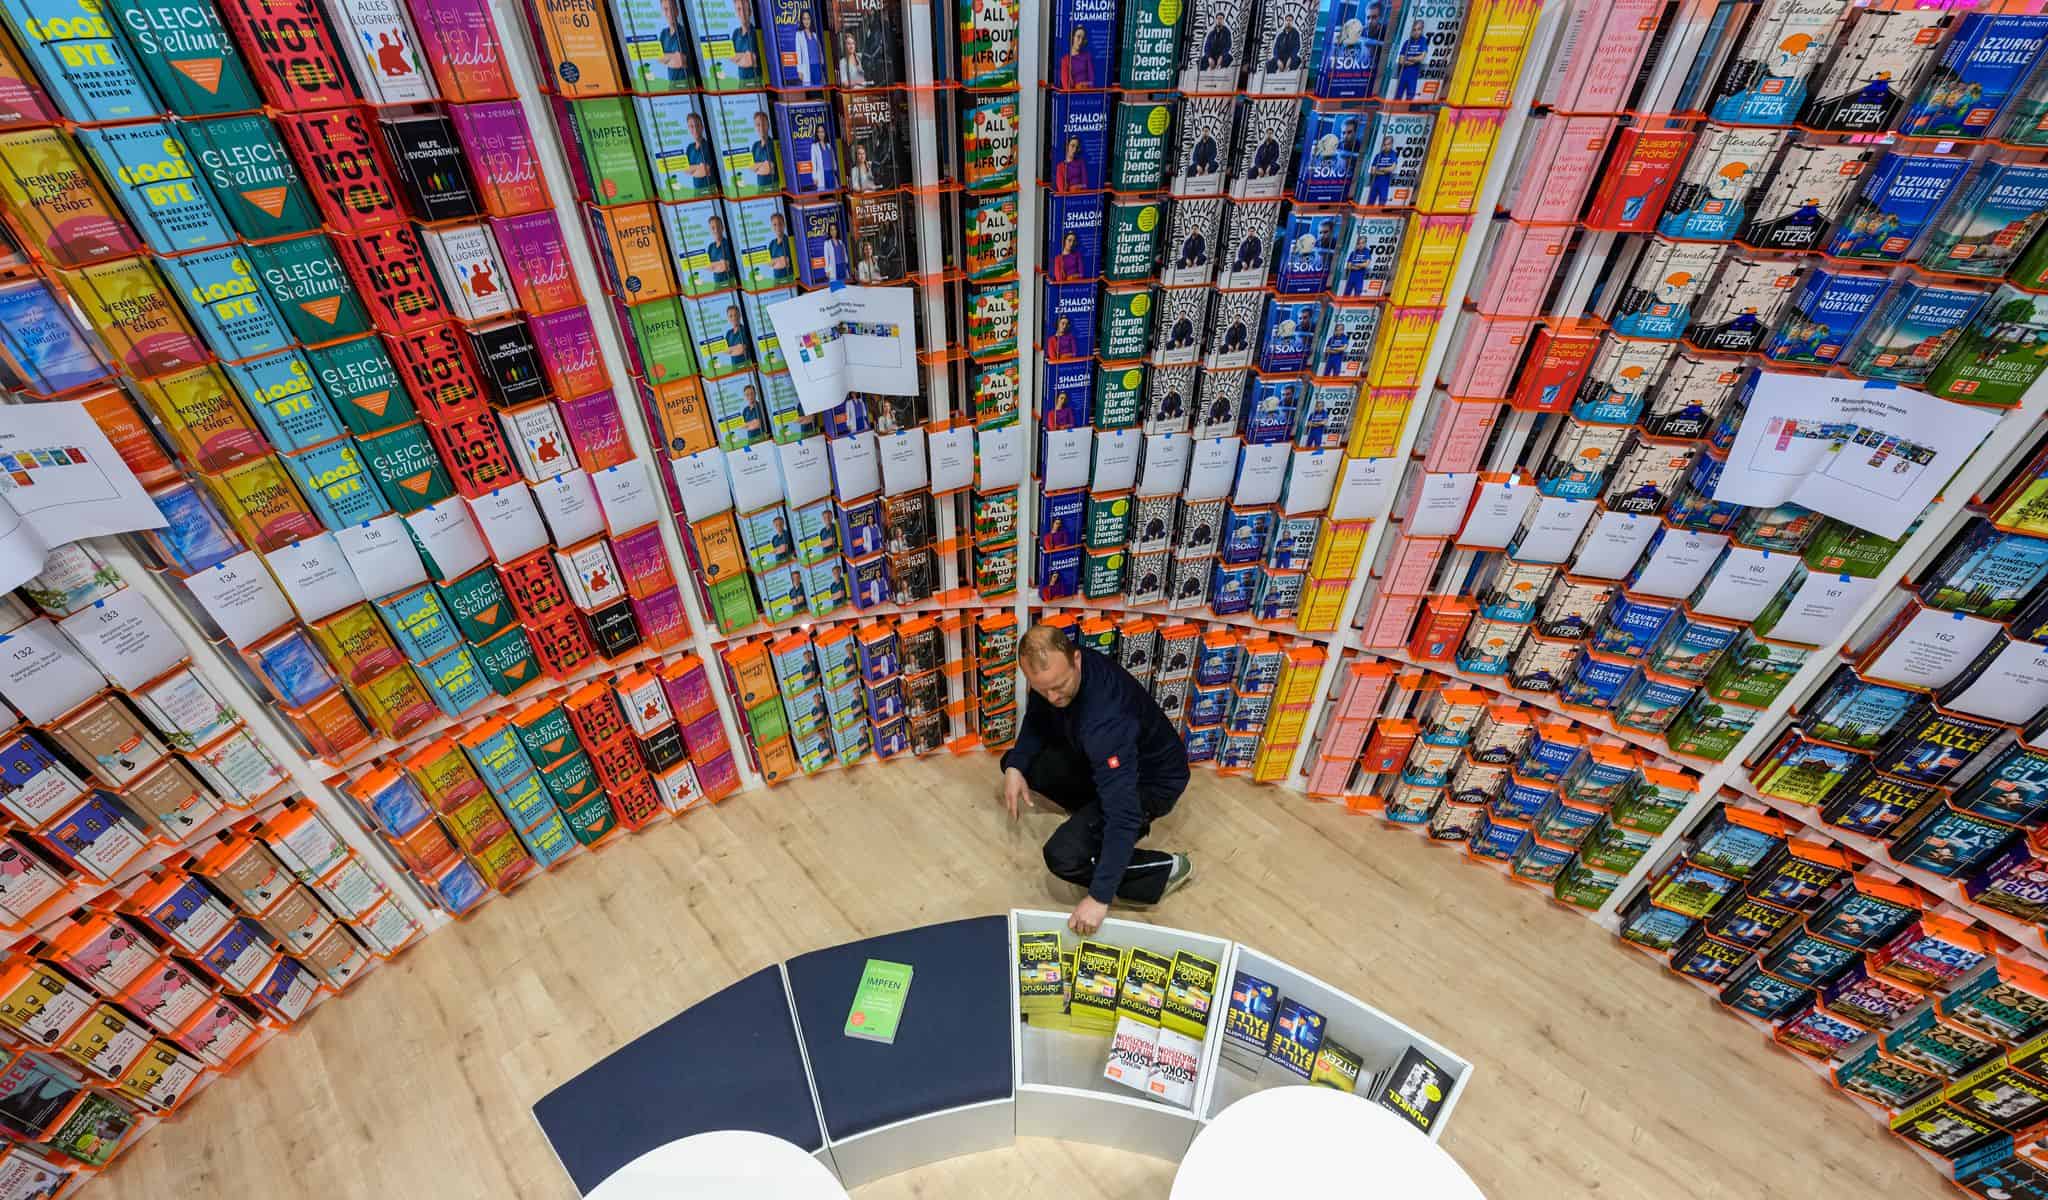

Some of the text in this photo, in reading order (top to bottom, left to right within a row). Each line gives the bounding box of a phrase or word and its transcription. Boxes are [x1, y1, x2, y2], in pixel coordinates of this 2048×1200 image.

[1075, 1, 1115, 11] SHALOM
[1411, 6, 1463, 19] TSOKOS
[125, 6, 221, 31] GLEICH
[572, 14, 590, 28] 60
[984, 8, 1005, 21] ALL
[1137, 11, 1152, 24] Zu
[249, 18, 321, 54] NOT
[975, 29, 1014, 42] ABOUT
[1426, 32, 1456, 46] TOD
[139, 31, 232, 55] Stellung
[1135, 41, 1172, 53] für die
[442, 40, 499, 64] nicht
[972, 51, 1014, 64] AFRICA
[1431, 48, 1452, 57] AUF
[1741, 102, 1785, 115] FITZEK
[794, 112, 825, 125] Genial
[863, 111, 891, 123] TRAB
[1070, 113, 1107, 123] SHALOM
[1836, 108, 1885, 123] FITZEK
[297, 114, 370, 148] IT'S
[985, 120, 1006, 132] ALL
[1127, 123, 1142, 134] Zu
[1381, 123, 1431, 135] TSOKOS
[975, 138, 1014, 150] ABOUT
[201, 144, 287, 169] GLEICH
[1125, 150, 1160, 160] für die
[1395, 147, 1423, 160] TOD
[311, 146, 374, 184] NOT
[974, 156, 1013, 170] AFRICA
[214, 164, 298, 189] Stellung
[487, 160, 539, 185] nicht
[809, 215, 837, 227] Genial
[872, 211, 898, 223] TRAB
[1686, 218, 1728, 232] FITZEK
[1772, 230, 1816, 242] FITZEK
[636, 237, 651, 249] 60
[265, 259, 344, 285] GLEICH
[368, 260, 421, 291] NOT
[276, 278, 349, 301] Stellung
[987, 302, 1006, 313] ALL
[1059, 298, 1095, 308] SHALOM
[1130, 326, 1143, 336] die
[1346, 331, 1370, 341] TOD
[1714, 334, 1754, 346] FITZEK
[410, 353, 465, 381] NOT
[681, 403, 694, 415] 60
[1594, 406, 1630, 419] FITZEK
[1664, 421, 1701, 435] FITZEK
[1557, 482, 1590, 494] FITZEK
[991, 503, 1007, 513] ALL
[1621, 499, 1655, 511] FITZEK
[434, 513, 448, 523] 137
[364, 529, 381, 540] 136
[716, 534, 728, 545] 60
[1293, 535, 1313, 544] TOD
[302, 558, 320, 570] 135
[992, 559, 1007, 568] ALL
[1749, 565, 1765, 574] 160
[219, 572, 237, 584] 134
[1826, 589, 1842, 597] 161
[100, 609, 119, 624] 133
[1495, 609, 1523, 620] FITZEK
[1551, 626, 1582, 636] FITZEK
[1935, 632, 1955, 642] 162
[12, 646, 34, 660] 132
[1919, 731, 1981, 752] FALLE
[1860, 788, 1921, 810] FALLE
[1028, 953, 1052, 961] ECHO
[1087, 962, 1110, 974] ECHO
[866, 976, 902, 990] IMPFEN
[1181, 973, 1206, 988] ECHO
[1166, 1000, 1206, 1020] Johnsrud
[1229, 1007, 1270, 1032] FALLE
[1274, 1033, 1315, 1060] FALLE
[1323, 1050, 1358, 1077] FITZEK
[1972, 1061, 2002, 1082] DUNKEL
[1389, 1088, 1429, 1127] DUNKEL
[1914, 1096, 1942, 1114] DUNKEL
[1936, 1108, 1992, 1135] DUNKEL
